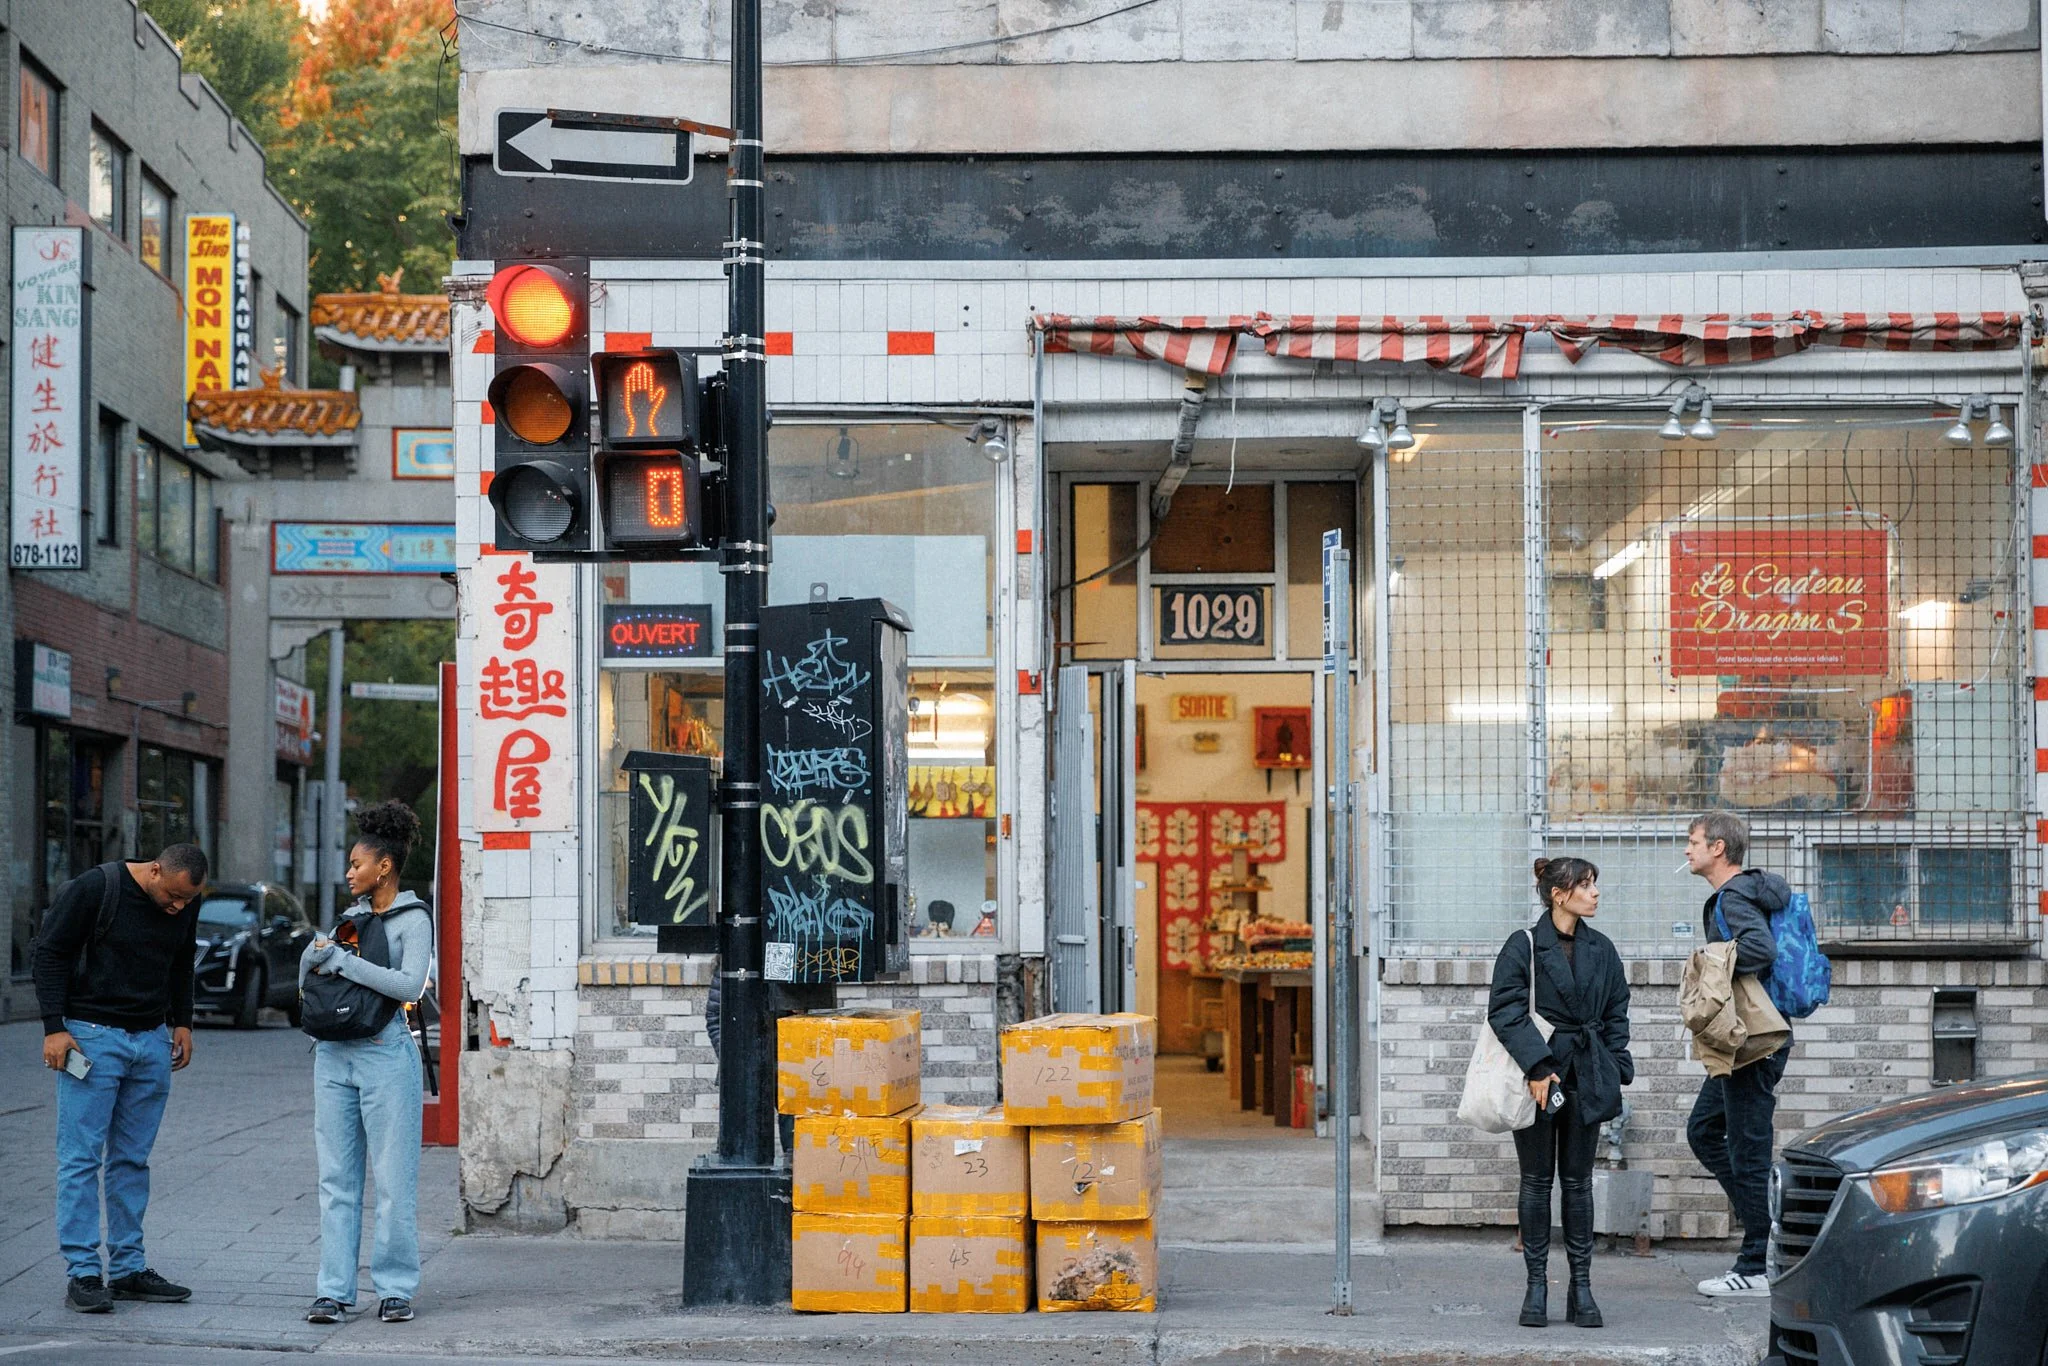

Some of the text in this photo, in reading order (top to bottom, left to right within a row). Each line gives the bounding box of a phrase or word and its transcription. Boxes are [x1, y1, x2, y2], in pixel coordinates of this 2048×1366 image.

[37, 284, 79, 305] KIN
[196, 267, 222, 328] MON
[236, 222, 251, 391] RESTAURAN
[14, 307, 79, 328] SANG
[27, 333, 65, 539] 健生旅行社
[648, 469, 684, 527] 0
[1691, 562, 1866, 600] Le Cadeau
[1171, 593, 1257, 639] 1029
[1694, 600, 1868, 640] Dragon S
[611, 622, 700, 646] OUVERT
[480, 560, 567, 819] 奇趣屋
[1178, 695, 1229, 718] SORTIE
[1035, 1066, 1073, 1086] 122
[964, 1158, 989, 1178] 23
[1071, 1162, 1097, 1180] 12
[837, 1249, 866, 1280] 94
[949, 1248, 972, 1270] 45
